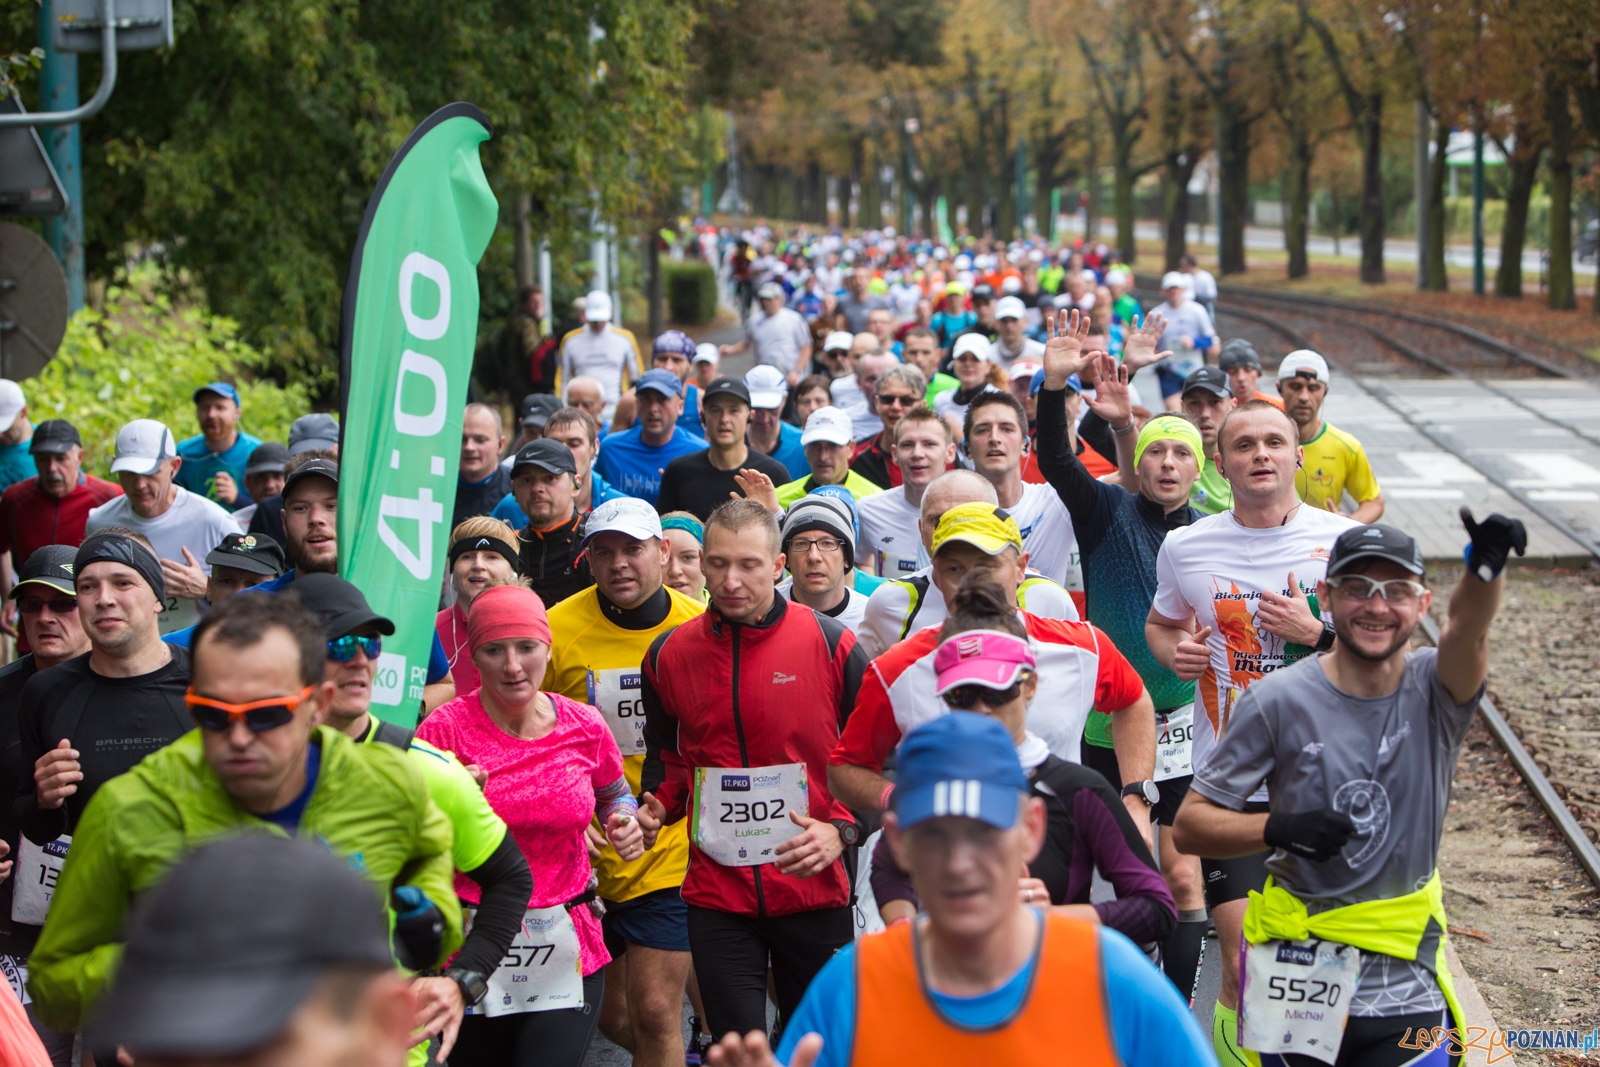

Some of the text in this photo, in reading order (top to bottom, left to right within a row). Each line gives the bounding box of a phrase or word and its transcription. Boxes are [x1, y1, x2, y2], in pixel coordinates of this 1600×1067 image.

[379, 250, 452, 581] 4:00
[623, 677, 642, 686] 17.P
[96, 737, 163, 746] BRUBECK
[723, 779, 748, 788] 17.PKO
[719, 798, 785, 823] 2302
[734, 827, 772, 838] Łukasz
[497, 944, 556, 967] 577
[512, 973, 528, 983] Iza
[1268, 975, 1341, 1007] 5520
[1285, 1009, 1324, 1021] Michał
